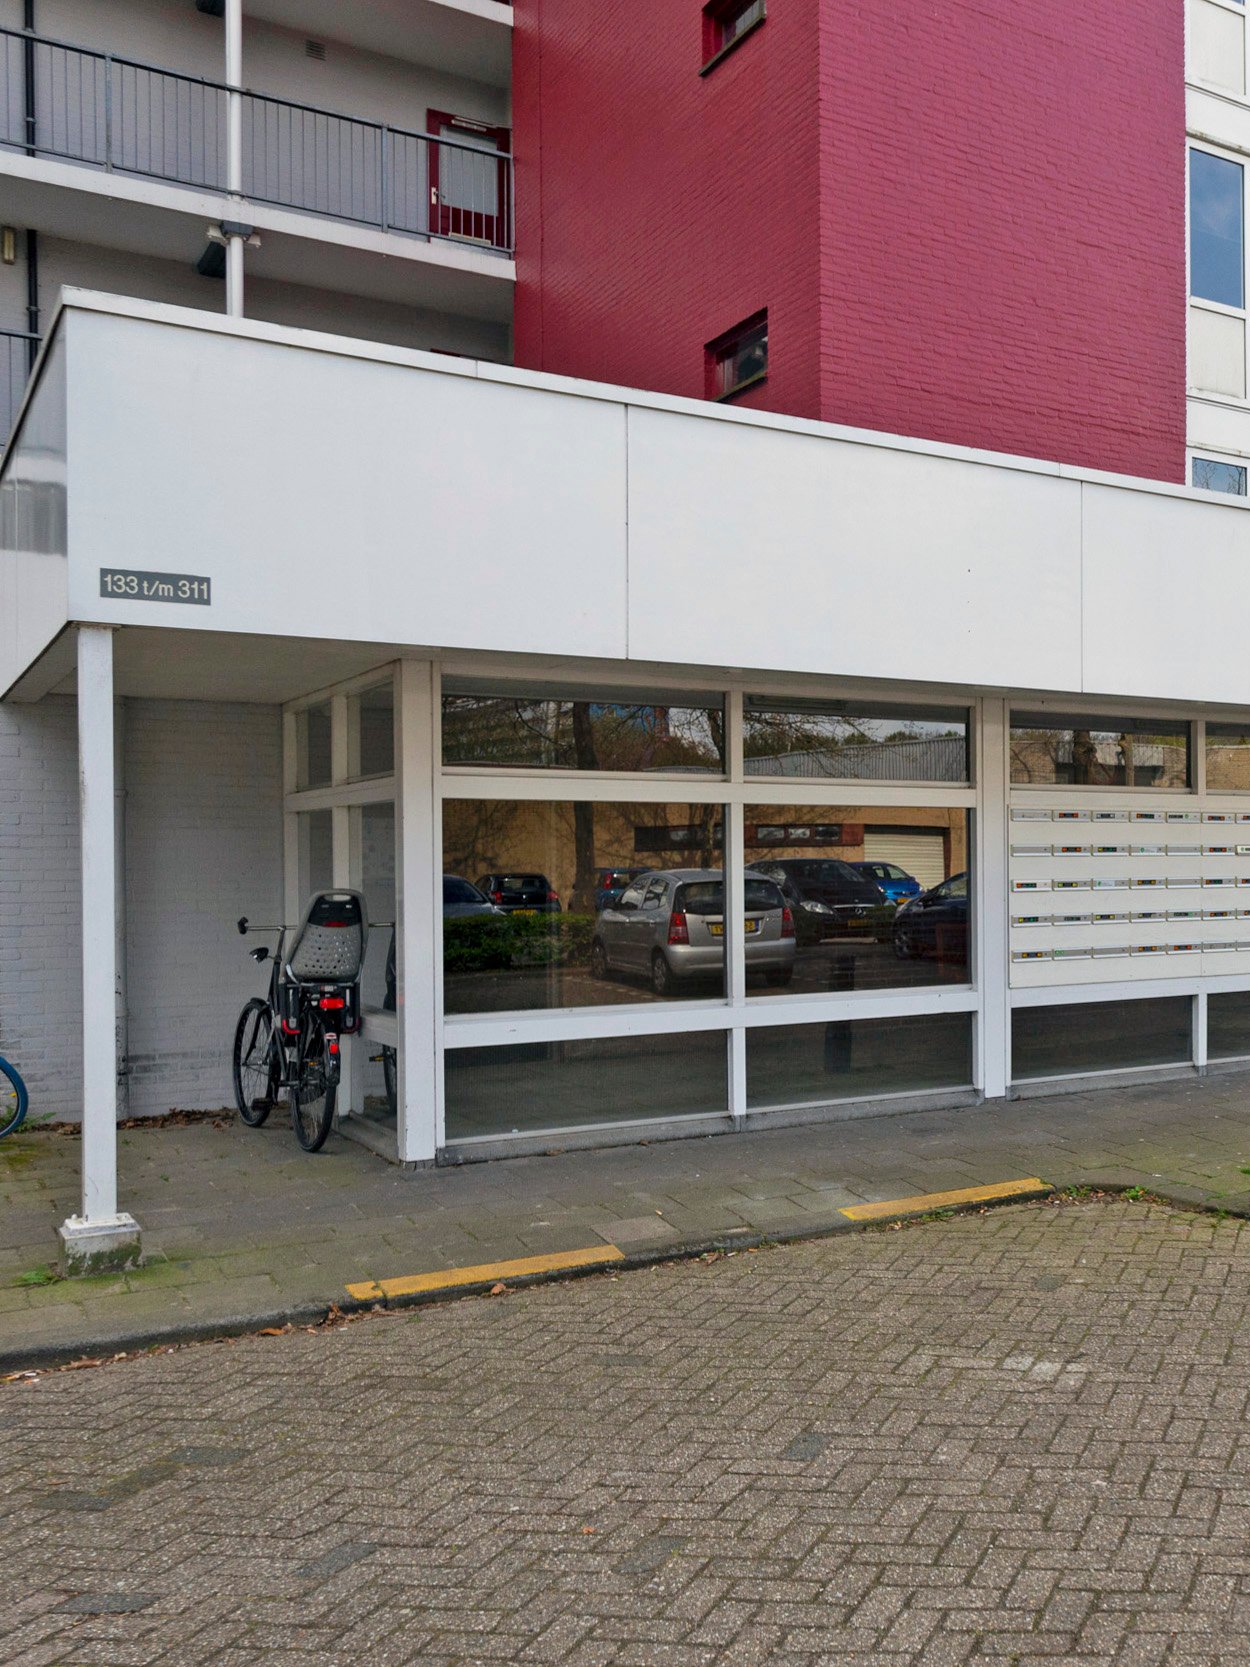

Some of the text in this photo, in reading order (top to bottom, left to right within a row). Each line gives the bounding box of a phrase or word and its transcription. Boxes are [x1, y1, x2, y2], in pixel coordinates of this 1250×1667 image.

[104, 574, 208, 599] 133 t/m 311
